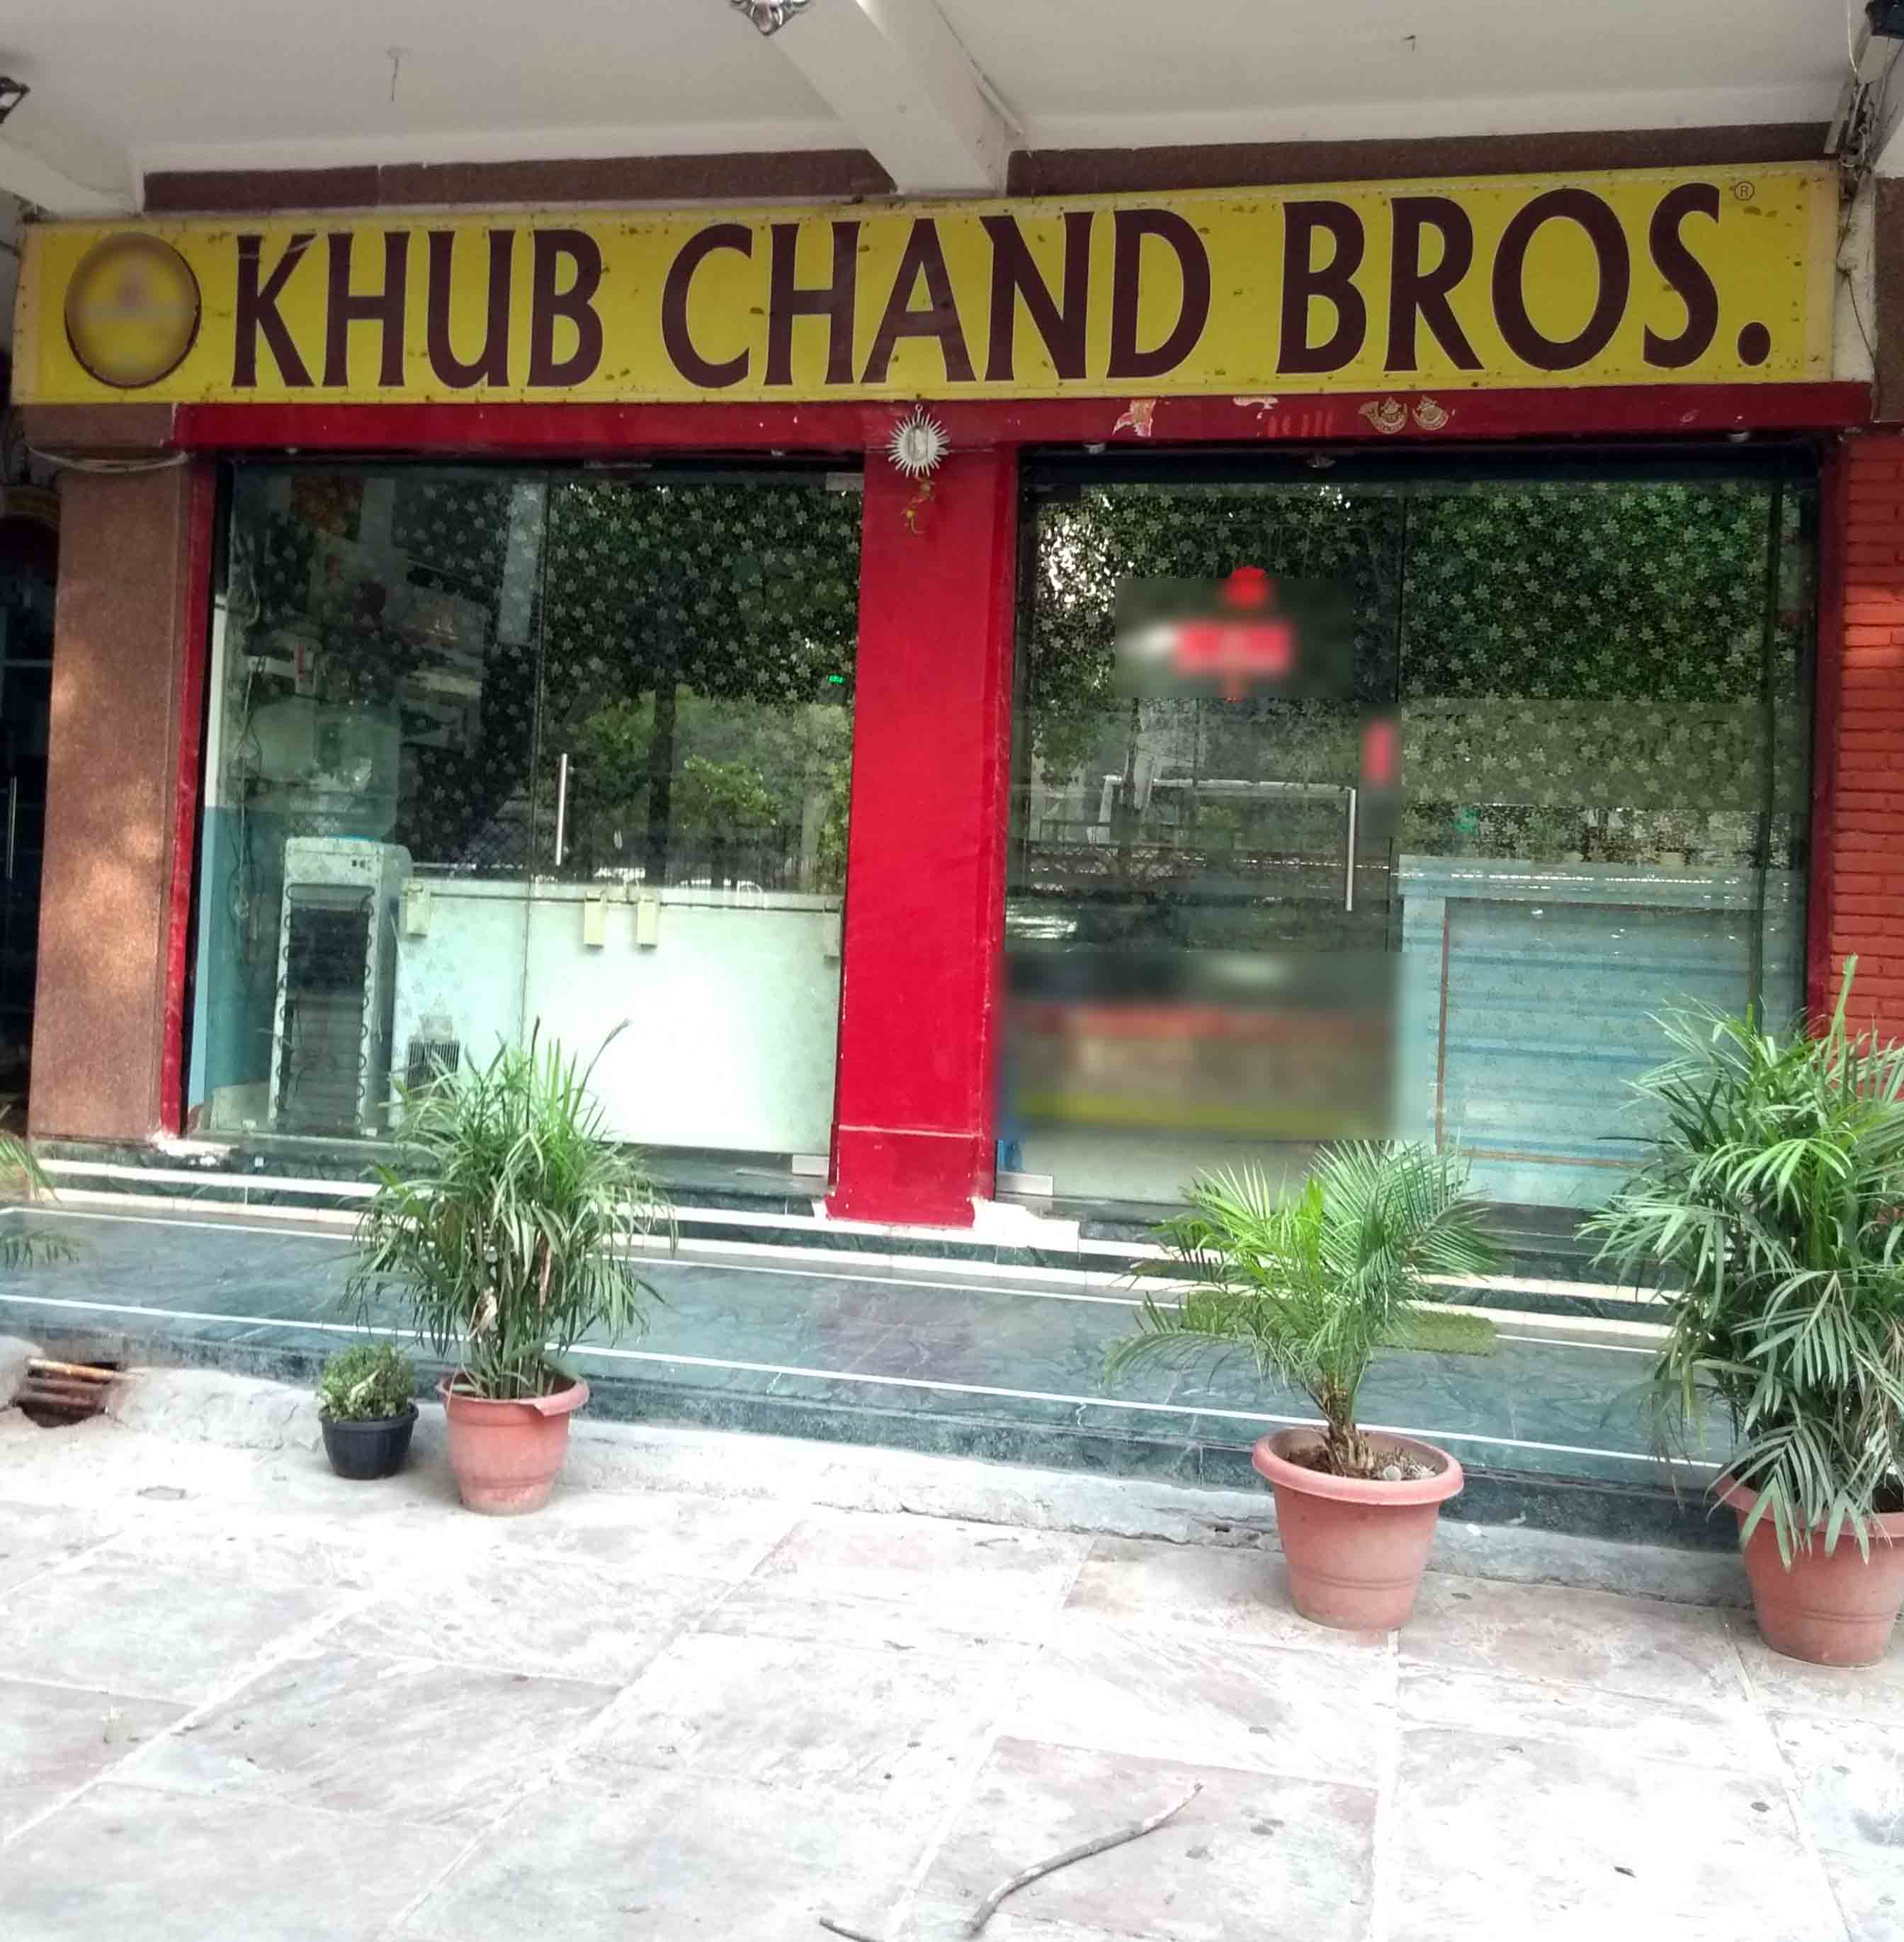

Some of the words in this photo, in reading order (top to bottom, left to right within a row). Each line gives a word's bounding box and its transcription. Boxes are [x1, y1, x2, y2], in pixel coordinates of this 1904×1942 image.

[231, 229, 604, 389] KHUB
[662, 208, 1211, 388] CHAND
[1276, 182, 1771, 374] BROS.
